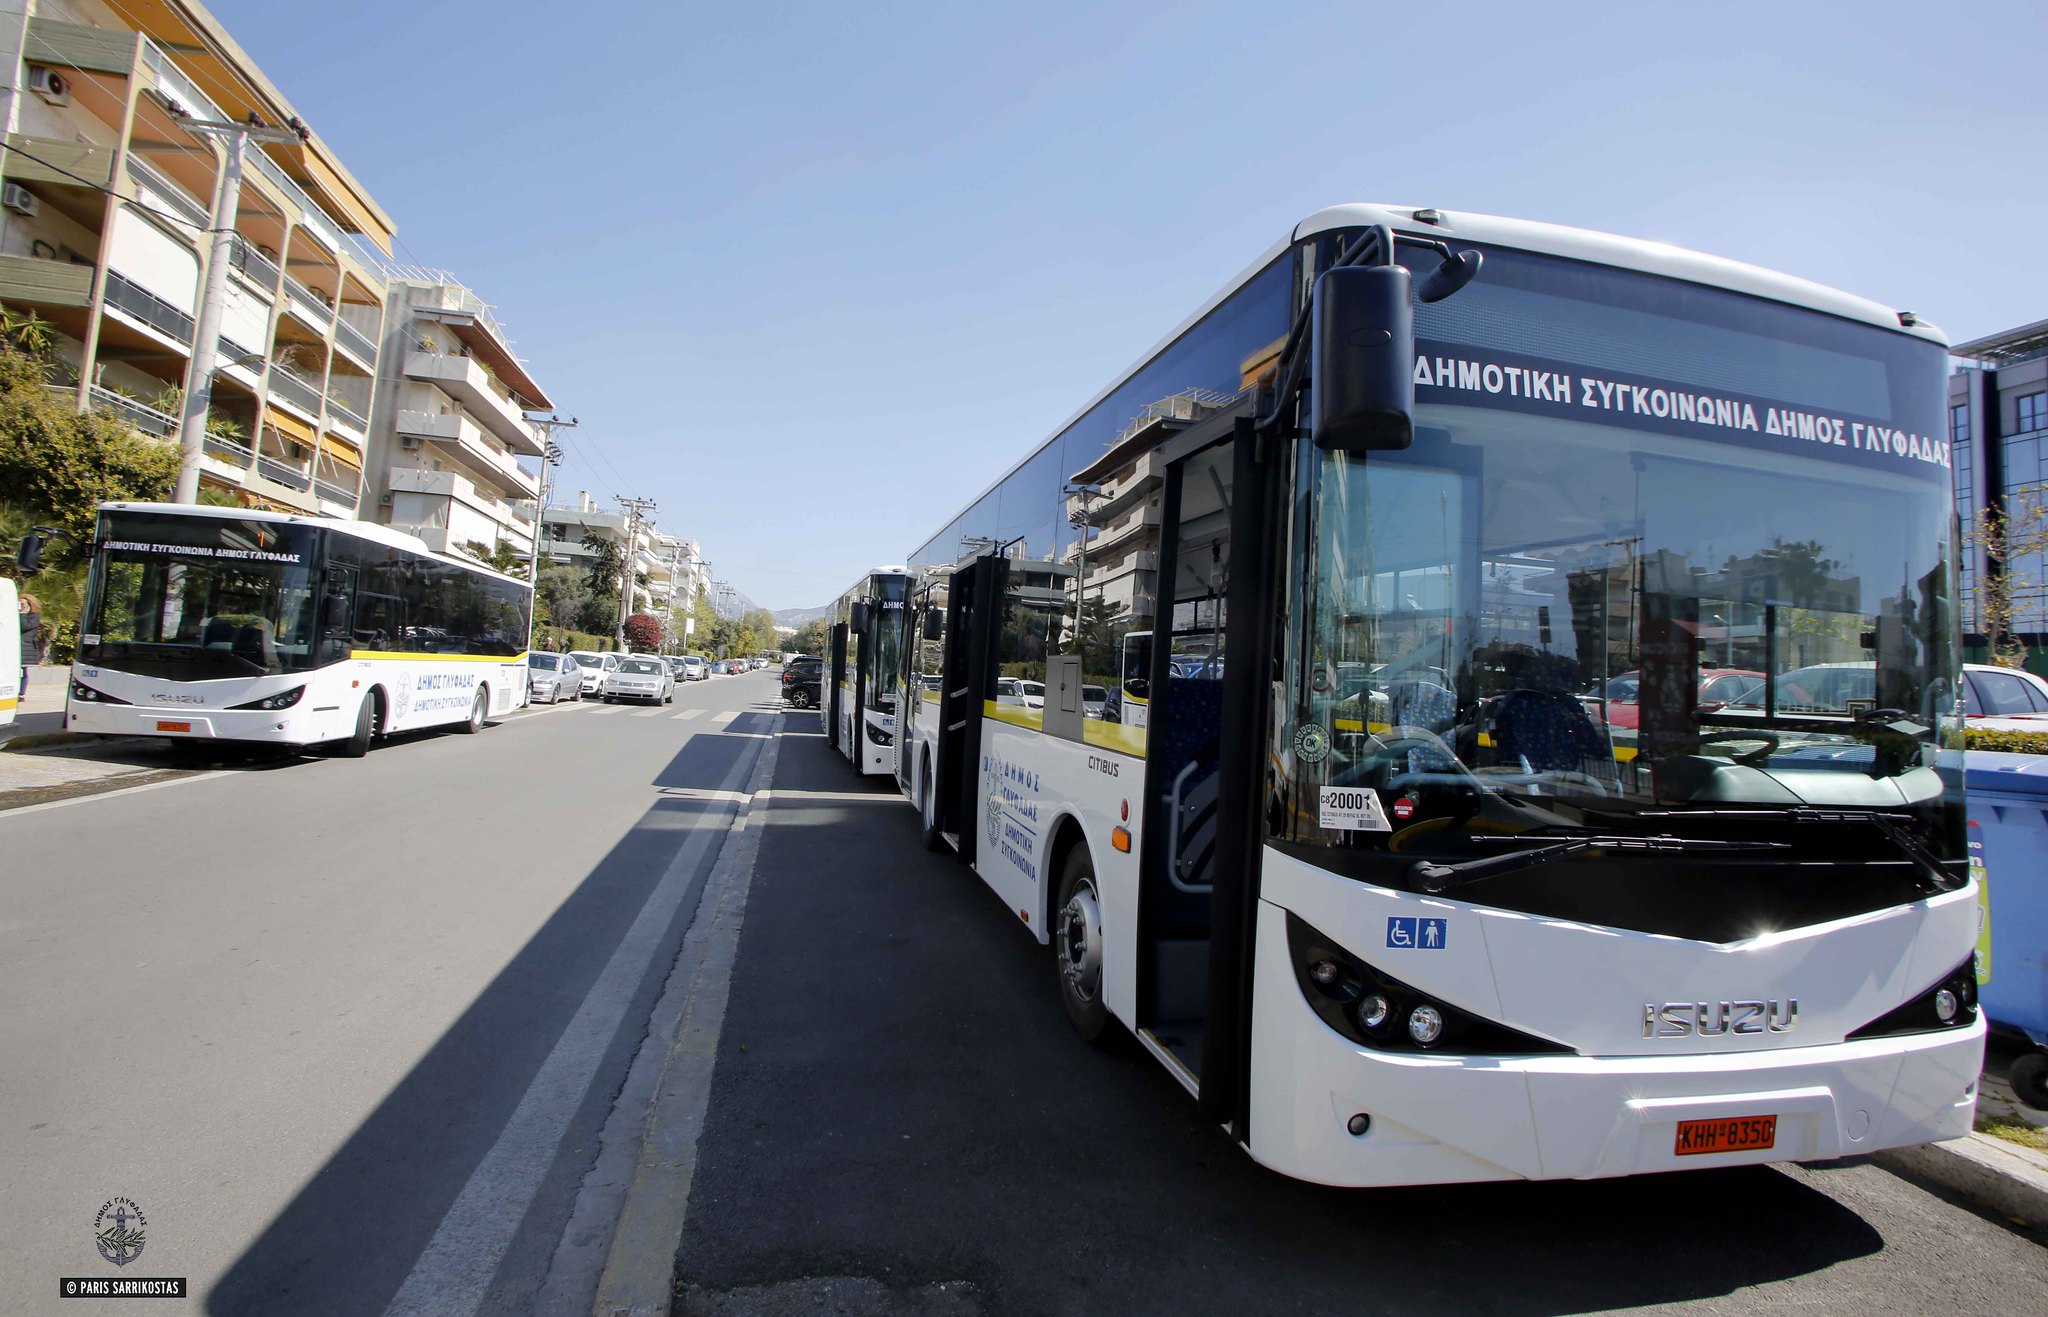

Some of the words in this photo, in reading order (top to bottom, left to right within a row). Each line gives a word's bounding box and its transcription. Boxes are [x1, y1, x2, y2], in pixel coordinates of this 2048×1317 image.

[1414, 356, 1571, 403] ΔΗΜΟΤΙΚΗ
[1581, 378, 1759, 432] ΣΥΓΚΟΙΝΩΝΙΑ
[1766, 408, 1847, 446] ΔΗΜΟΣ
[1852, 423, 1951, 468] ΓΛΥΦΑΔΑΣ
[103, 541, 150, 552] ΔΗΜΟΤΙΚΗ
[152, 544, 213, 556] ΣΥΓΚΟΙΝΩΝΙΑ
[215, 549, 249, 559] ΔΗΜΟΣ
[251, 551, 300, 563] ΓΛΥΦΑΔΑΣ
[1004, 761, 1039, 792] ΔΗΜΟΣ
[1088, 756, 1119, 777] CITIBUS
[1005, 823, 1033, 855] ΔΗΜΟΤΙΚΗ
[1641, 999, 1798, 1039] ISUZU
